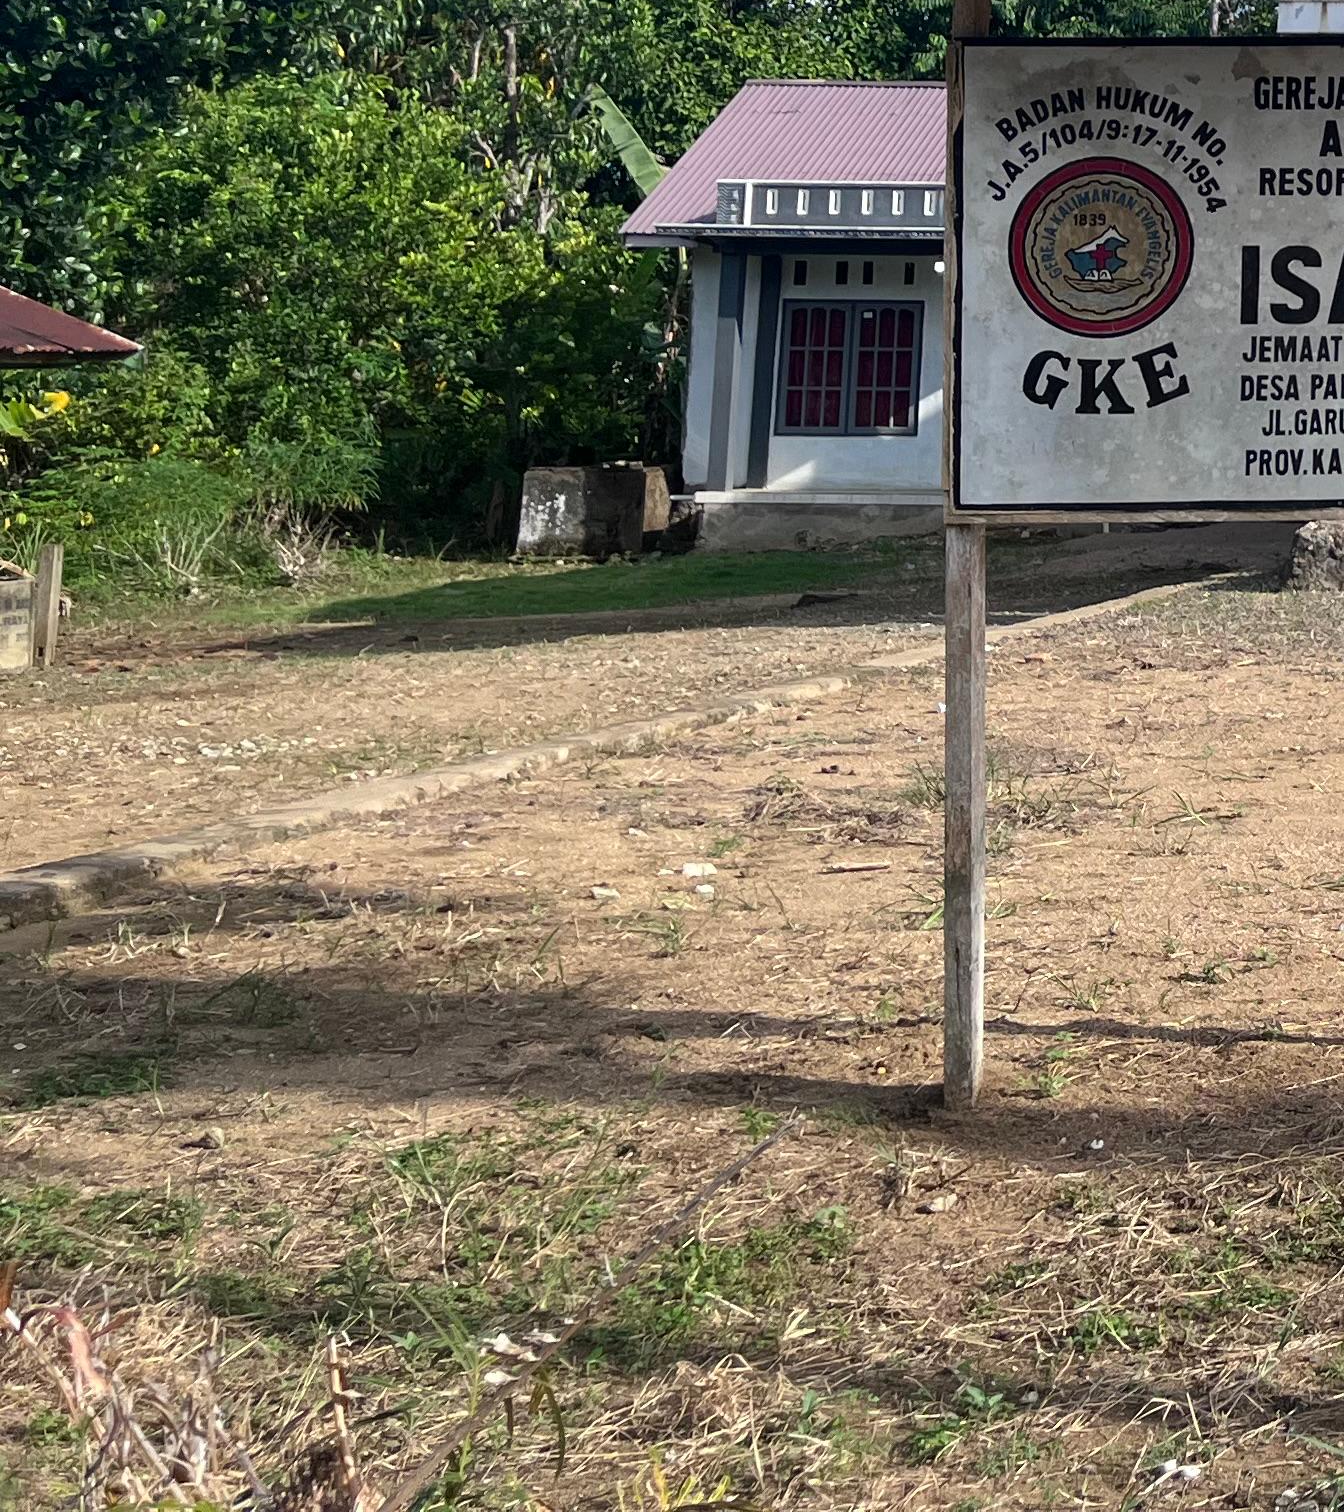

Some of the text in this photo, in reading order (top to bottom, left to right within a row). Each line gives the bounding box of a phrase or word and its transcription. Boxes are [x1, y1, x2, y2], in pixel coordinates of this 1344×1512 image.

[995, 86, 1227, 167] BADAN HUKUM NO.
[1051, 188, 1138, 225] KALIMANTAN
[1135, 206, 1162, 280] EVANGELIS
[1073, 213, 1107, 227] 1839
[1242, 334, 1343, 363] JEMAAT
[1022, 341, 1191, 415] GKE
[1240, 373, 1300, 401] DESA
